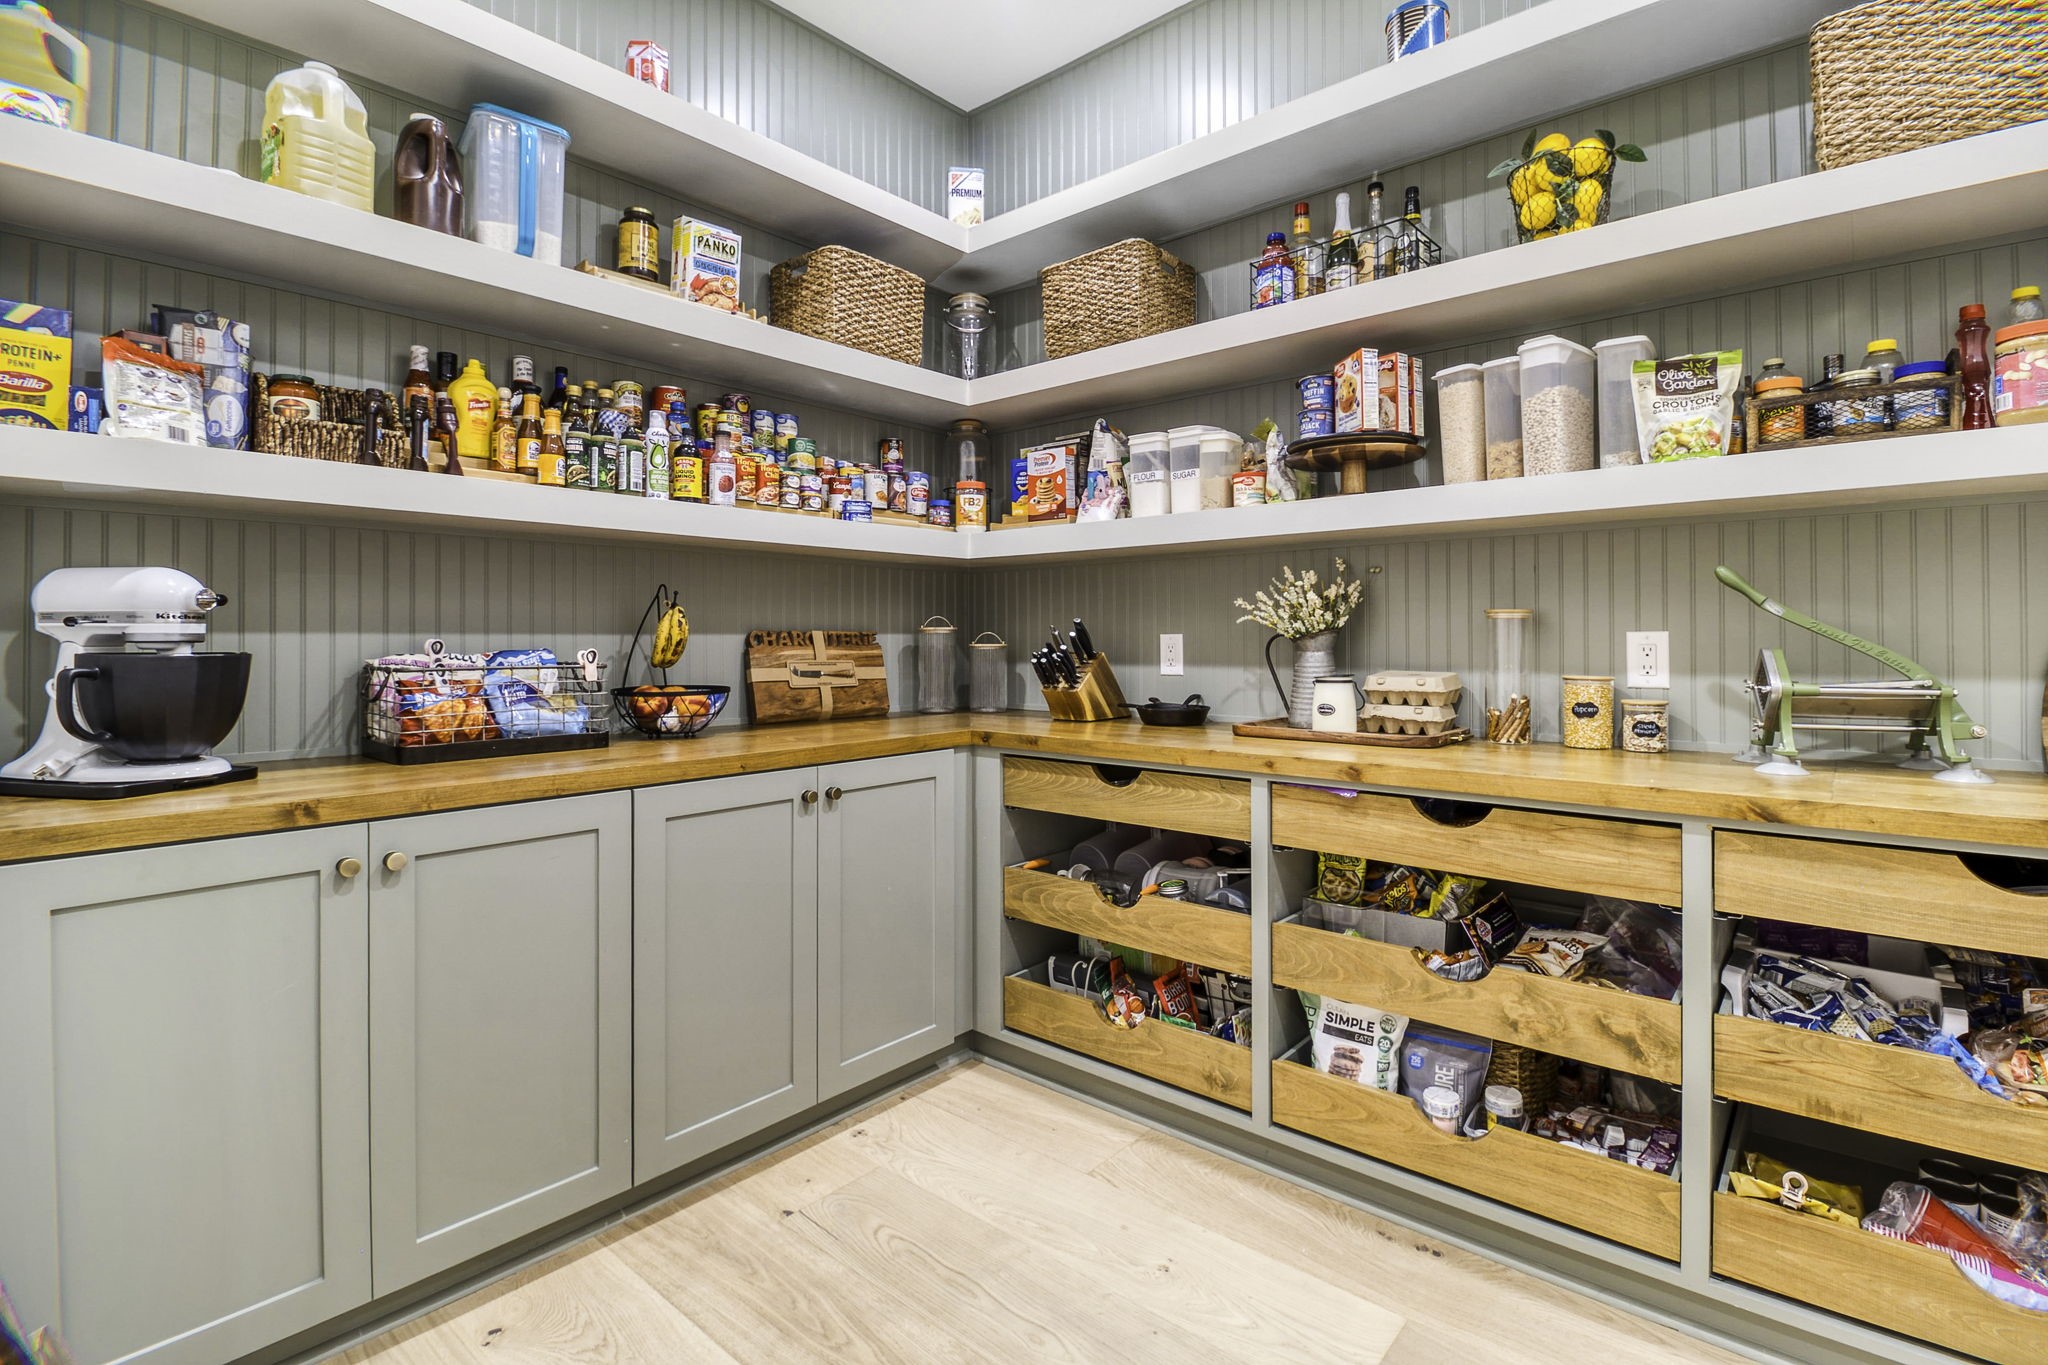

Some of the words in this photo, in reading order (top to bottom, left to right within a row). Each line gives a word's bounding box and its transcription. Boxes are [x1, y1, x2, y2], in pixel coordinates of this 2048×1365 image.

[951, 188, 982, 198] PREMIUM
[697, 235, 736, 256] PANKO
[0, 343, 62, 361] ROTEIN+
[8, 358, 36, 370] PENNE
[1657, 369, 1694, 381] Olive
[1662, 377, 1716, 392] Garden
[1303, 388, 1325, 397] MUFFIN
[1652, 394, 1722, 409] CROUTONS
[1133, 472, 1156, 481] FLOUR
[1172, 469, 1196, 480] SUGAR
[963, 498, 981, 507] PB2
[749, 630, 878, 648] CHARCTERIE
[1574, 705, 1598, 714] Popcorn
[1325, 1011, 1376, 1034] SIMPLE
[1354, 1033, 1373, 1045] EATS
